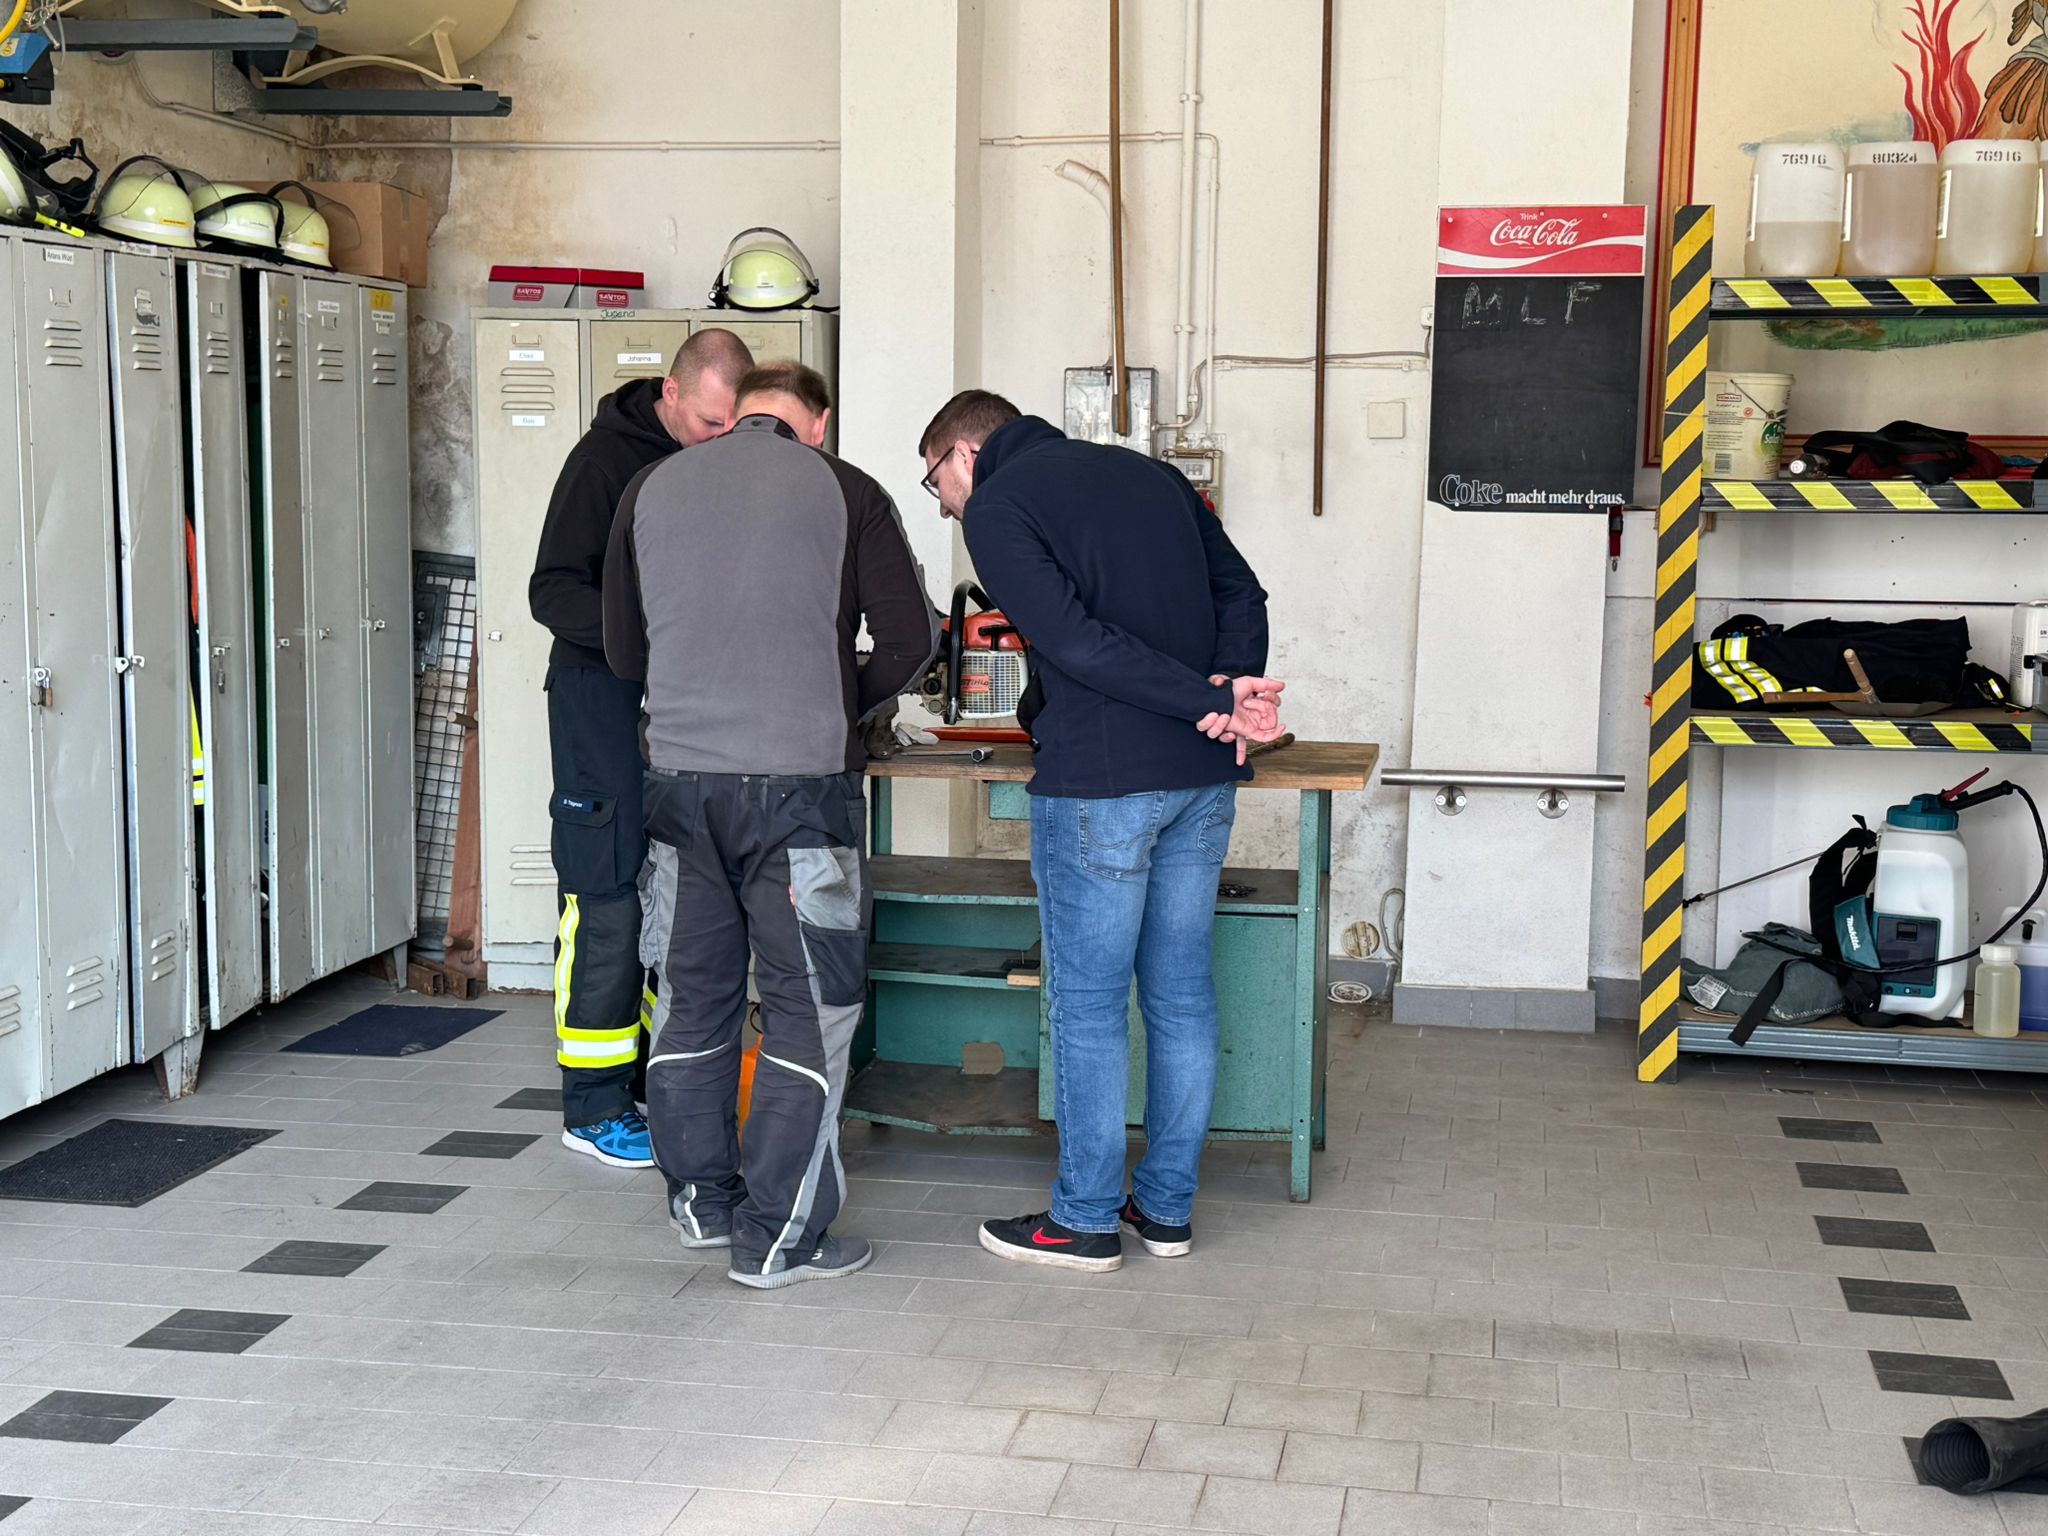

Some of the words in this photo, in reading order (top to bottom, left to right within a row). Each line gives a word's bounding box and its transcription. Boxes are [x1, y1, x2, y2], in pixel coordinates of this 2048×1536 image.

[1781, 153, 1827, 165] 76916
[1872, 152, 1918, 163] 80324
[1975, 150, 2022, 162] 76916
[1519, 212, 1538, 221] Trink
[1489, 218, 1583, 246] Coca-Cola
[516, 287, 542, 296] SANTOS
[598, 293, 626, 302] SANTOS
[600, 309, 636, 320] Jugend
[627, 355, 652, 363] Johanna
[1439, 474, 1503, 504] Coke
[1505, 489, 1547, 505] macht
[1548, 489, 1585, 505] mehr
[1584, 490, 1627, 505] draus.
[1846, 914, 1861, 951] makita
